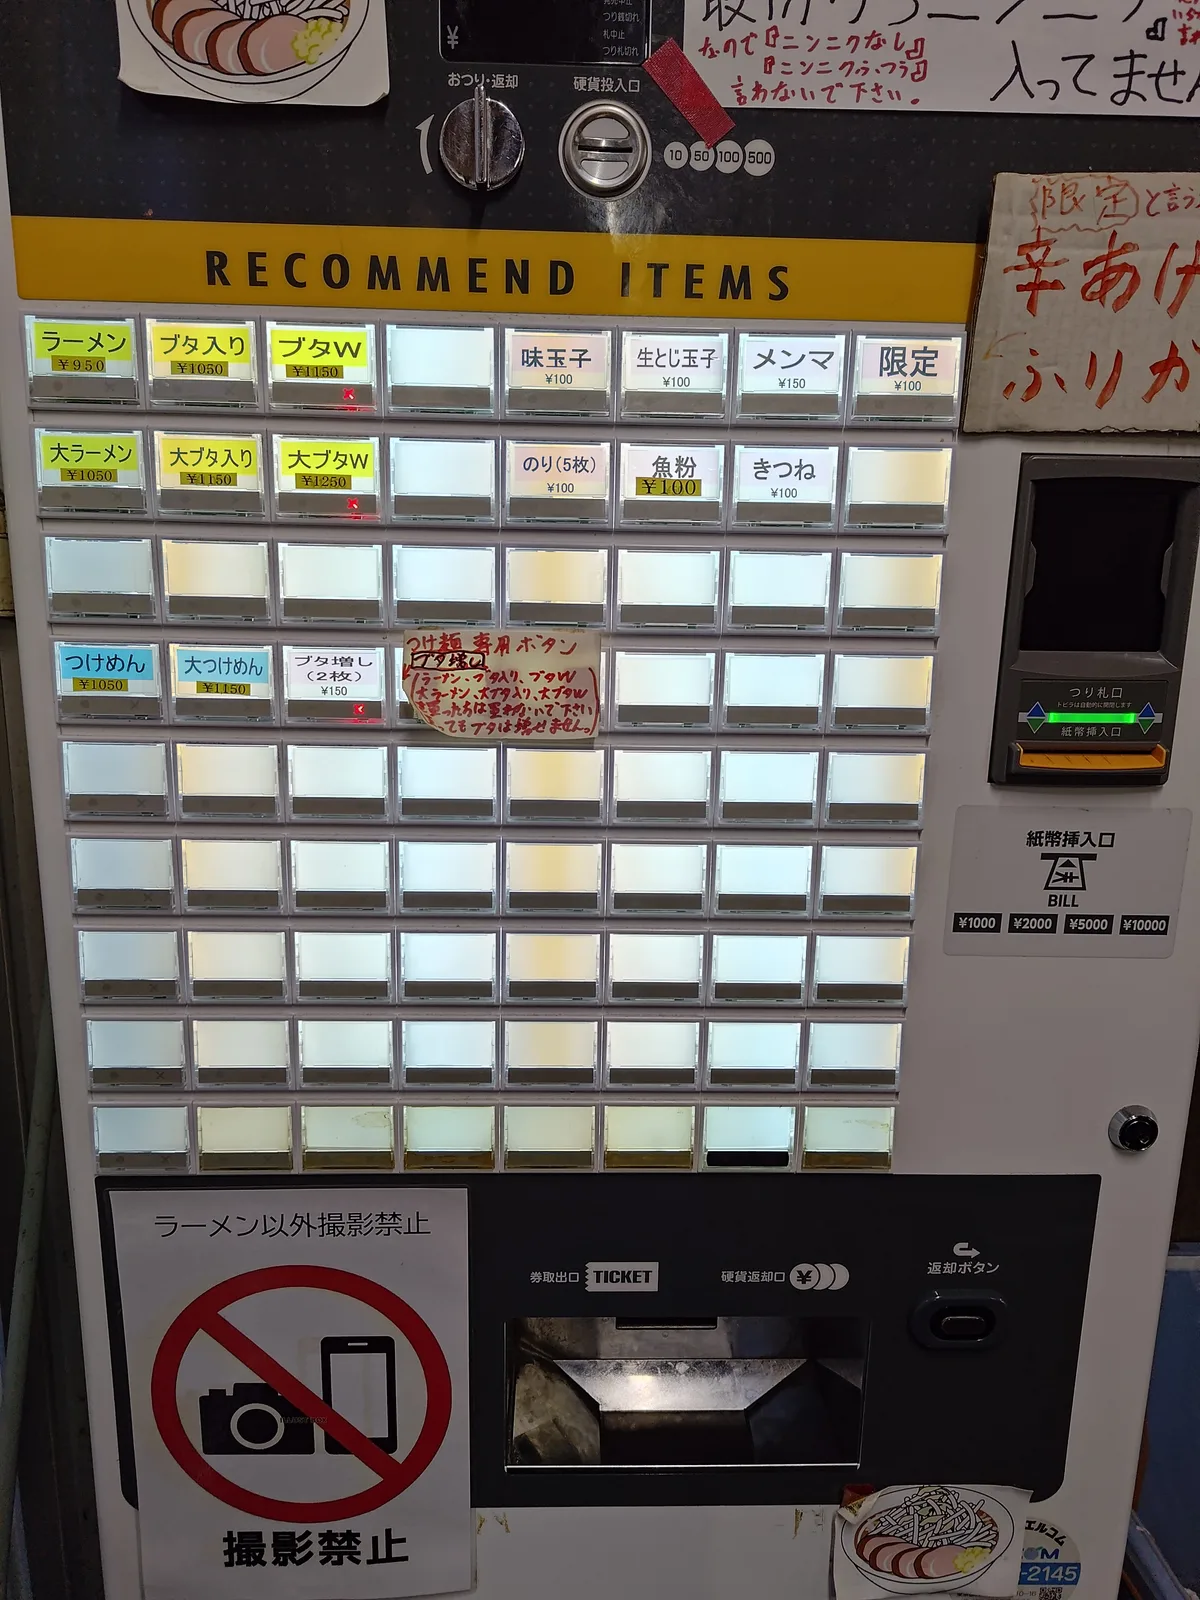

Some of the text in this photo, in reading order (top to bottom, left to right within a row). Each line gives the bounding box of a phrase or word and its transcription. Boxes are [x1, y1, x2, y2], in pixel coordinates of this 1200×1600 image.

[603, 11, 640, 22] つり銭切れ
[603, 29, 625, 40] 札中止
[603, 46, 639, 56] つり札切れ
[447, 73, 519, 88] おつり・返却
[573, 76, 640, 93] 硬貨投入口
[731, 75, 920, 106] 言わないで下さい。
[669, 149, 772, 165] 10 50 100 500
[206, 250, 790, 301] RECOMMEND ITEMS
[41, 331, 127, 354] ラーメン
[159, 334, 246, 357] ブタ入り
[277, 338, 362, 359] ブタW
[57, 359, 105, 372] ¥950
[521, 347, 592, 369] 味玉子
[636, 347, 719, 369] 生とじ玉子
[752, 347, 836, 371] メンマ
[879, 346, 939, 378] 限定
[176, 361, 224, 375] ¥1050
[292, 365, 339, 378] ¥1150
[545, 373, 573, 385] ¥100
[662, 376, 691, 388] ¥100
[778, 378, 806, 389] ¥150
[894, 380, 922, 392] ¥100
[49, 442, 133, 464] 大ラーメン
[169, 446, 253, 469] 大ブタ入り
[287, 450, 369, 471] 大ブタW
[522, 454, 597, 475] のり(5枚)
[651, 454, 697, 479] 魚粉
[752, 457, 816, 481] きつね
[66, 469, 113, 482] ¥1050
[185, 473, 233, 486] ¥1150
[300, 475, 347, 488] ¥1250
[547, 482, 575, 494] ¥100
[641, 480, 696, 495] ¥100
[770, 487, 798, 499] ¥100
[65, 653, 146, 673] つけめん
[184, 655, 264, 677] 大つけめん
[294, 655, 373, 668] ブタ増し
[306, 670, 362, 682] (2枚)
[78, 678, 124, 691] ¥1050
[202, 683, 246, 695] ¥1150
[321, 685, 348, 696] ¥150
[1069, 687, 1123, 699] つり札口
[1061, 726, 1122, 737] 紙幣挿入口
[1026, 830, 1116, 848] 紙幣挿入口
[1047, 894, 1079, 908] BILL
[958, 916, 1167, 931] ¥1000 ¥2000 ¥5000 ¥10000
[153, 1211, 432, 1239] ラーメン以外撮影禁止
[926, 1260, 1000, 1276] 返却ボタン
[529, 1270, 579, 1284] 券取出口
[592, 1269, 652, 1284] TICKET
[721, 1270, 786, 1284] 硬貨返却口
[222, 1527, 409, 1568] 撮影禁止
